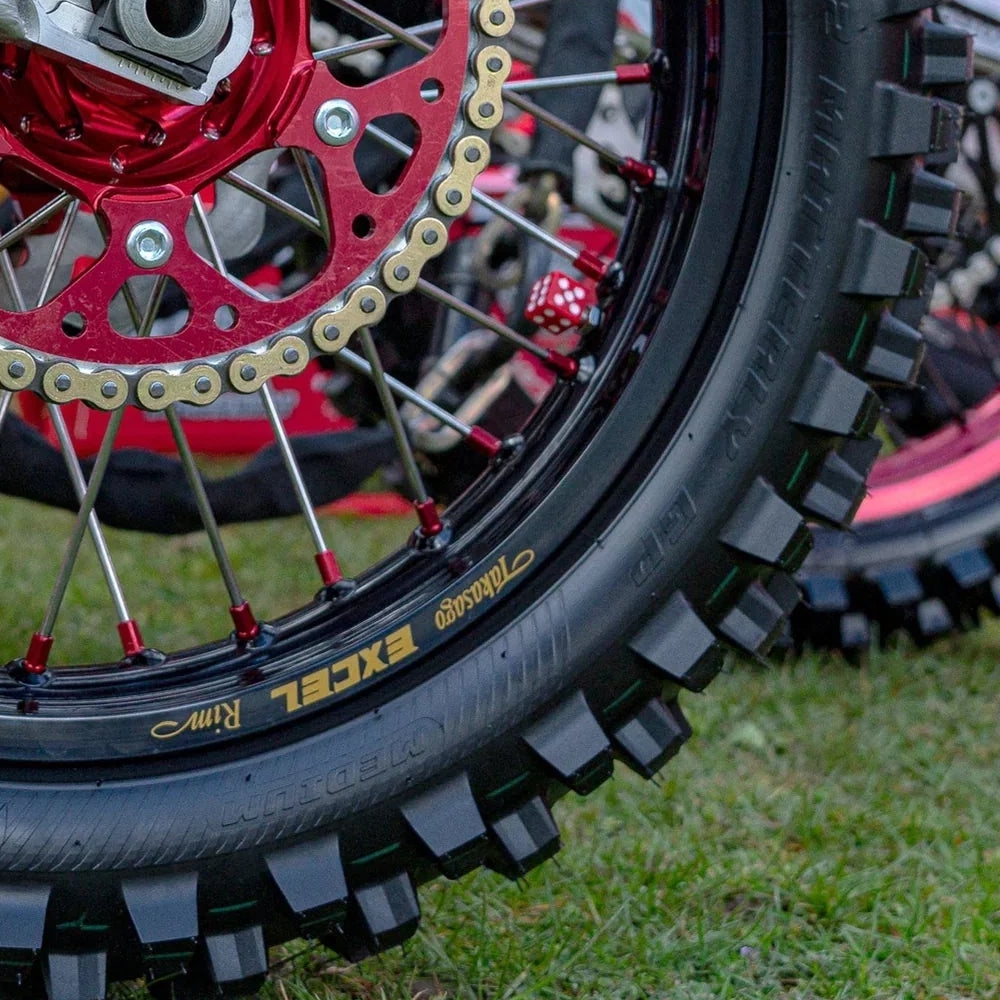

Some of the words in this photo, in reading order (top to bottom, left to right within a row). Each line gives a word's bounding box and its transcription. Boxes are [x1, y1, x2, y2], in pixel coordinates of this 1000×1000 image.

[434, 548, 536, 631] Takasago
[270, 624, 419, 713] EXCEL
[151, 698, 242, 740] Rim
[220, 736, 429, 827] MEDIUM
